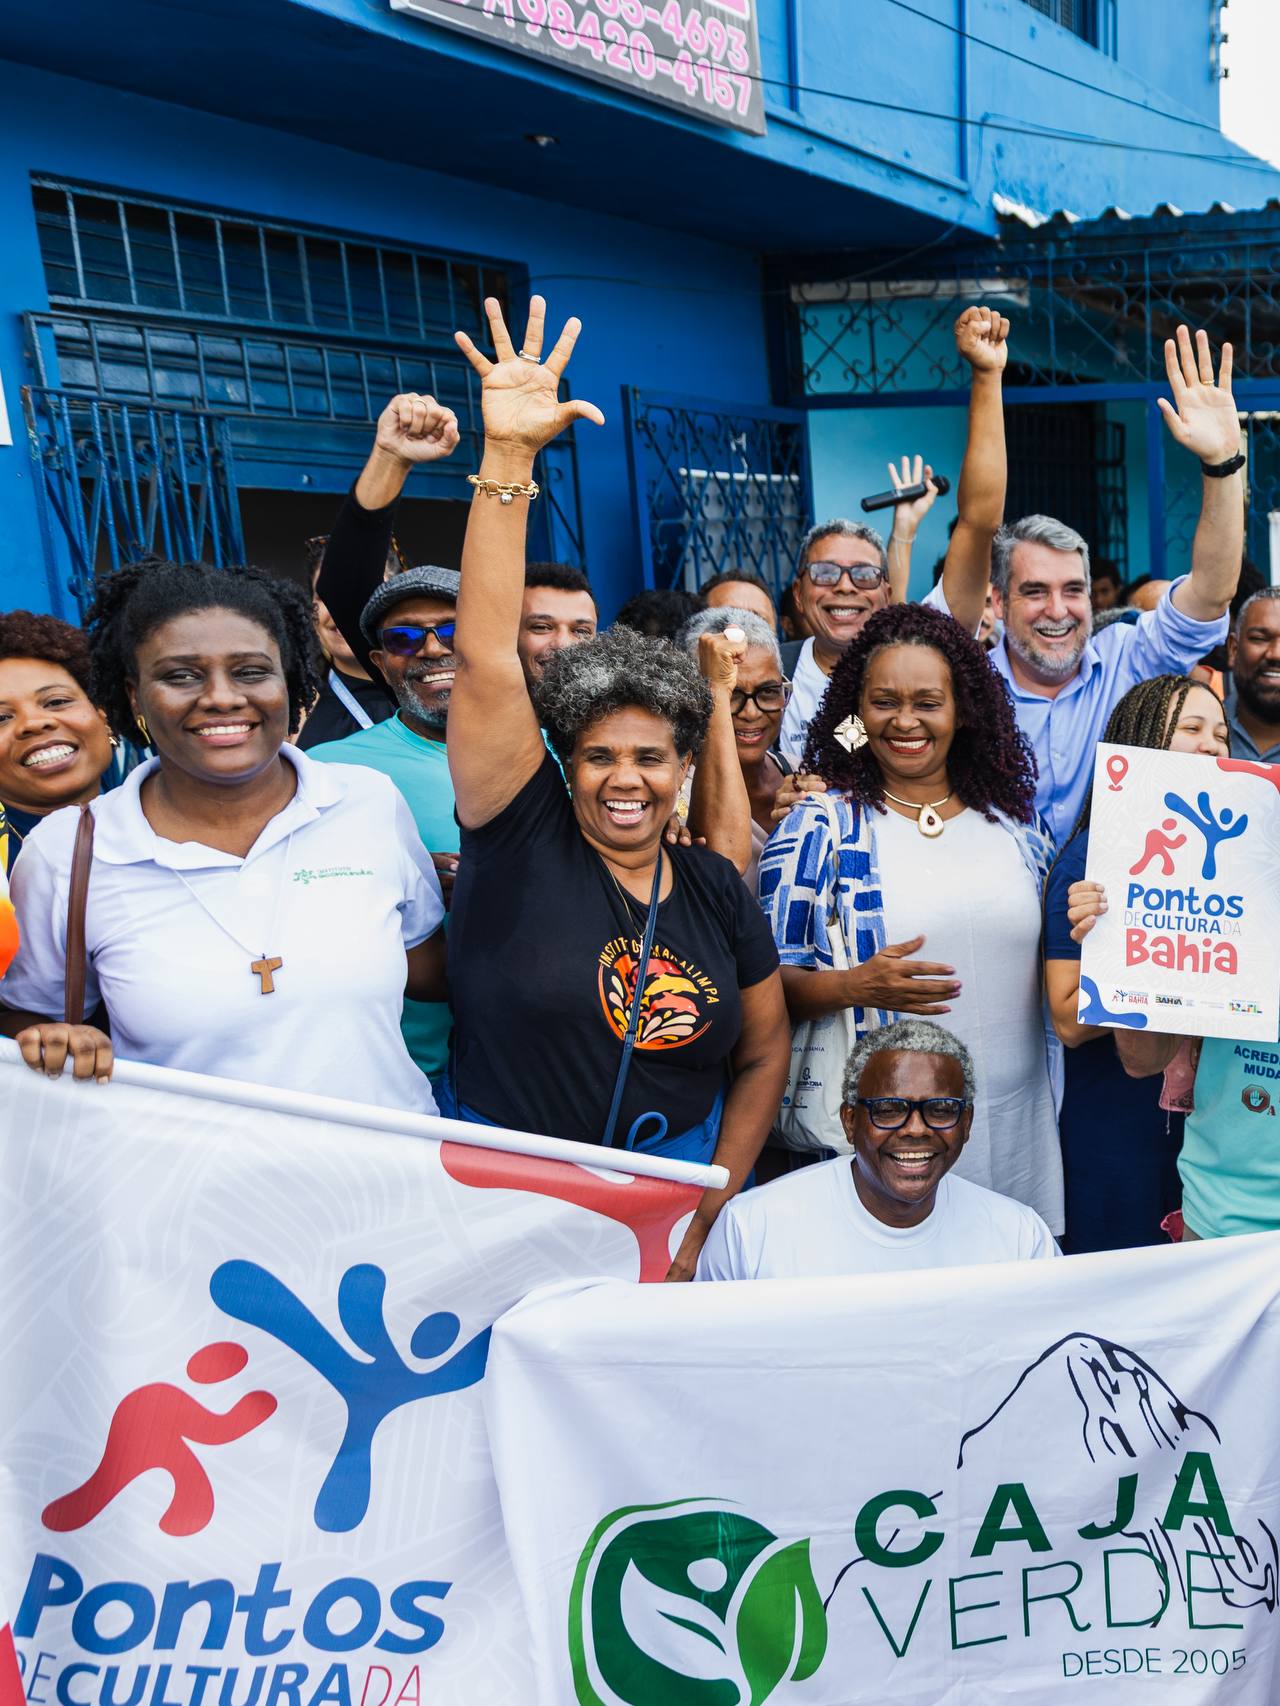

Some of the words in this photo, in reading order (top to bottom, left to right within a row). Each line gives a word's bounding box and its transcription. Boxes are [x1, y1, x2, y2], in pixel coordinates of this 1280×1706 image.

[1127, 883, 1244, 918] Pontos
[1142, 913, 1222, 935] CULTURA
[1125, 928, 1238, 975] Bahia
[1266, 1105, 1277, 1117] A
[854, 1451, 1237, 1568] CAJA
[13, 1552, 454, 1657] Pontos
[861, 1548, 1244, 1659] VERDE
[56, 1662, 353, 1706] CULTURA
[360, 1664, 422, 1706] DA
[1062, 1647, 1163, 1678] DESDE
[1172, 1647, 1248, 1677] 2005
